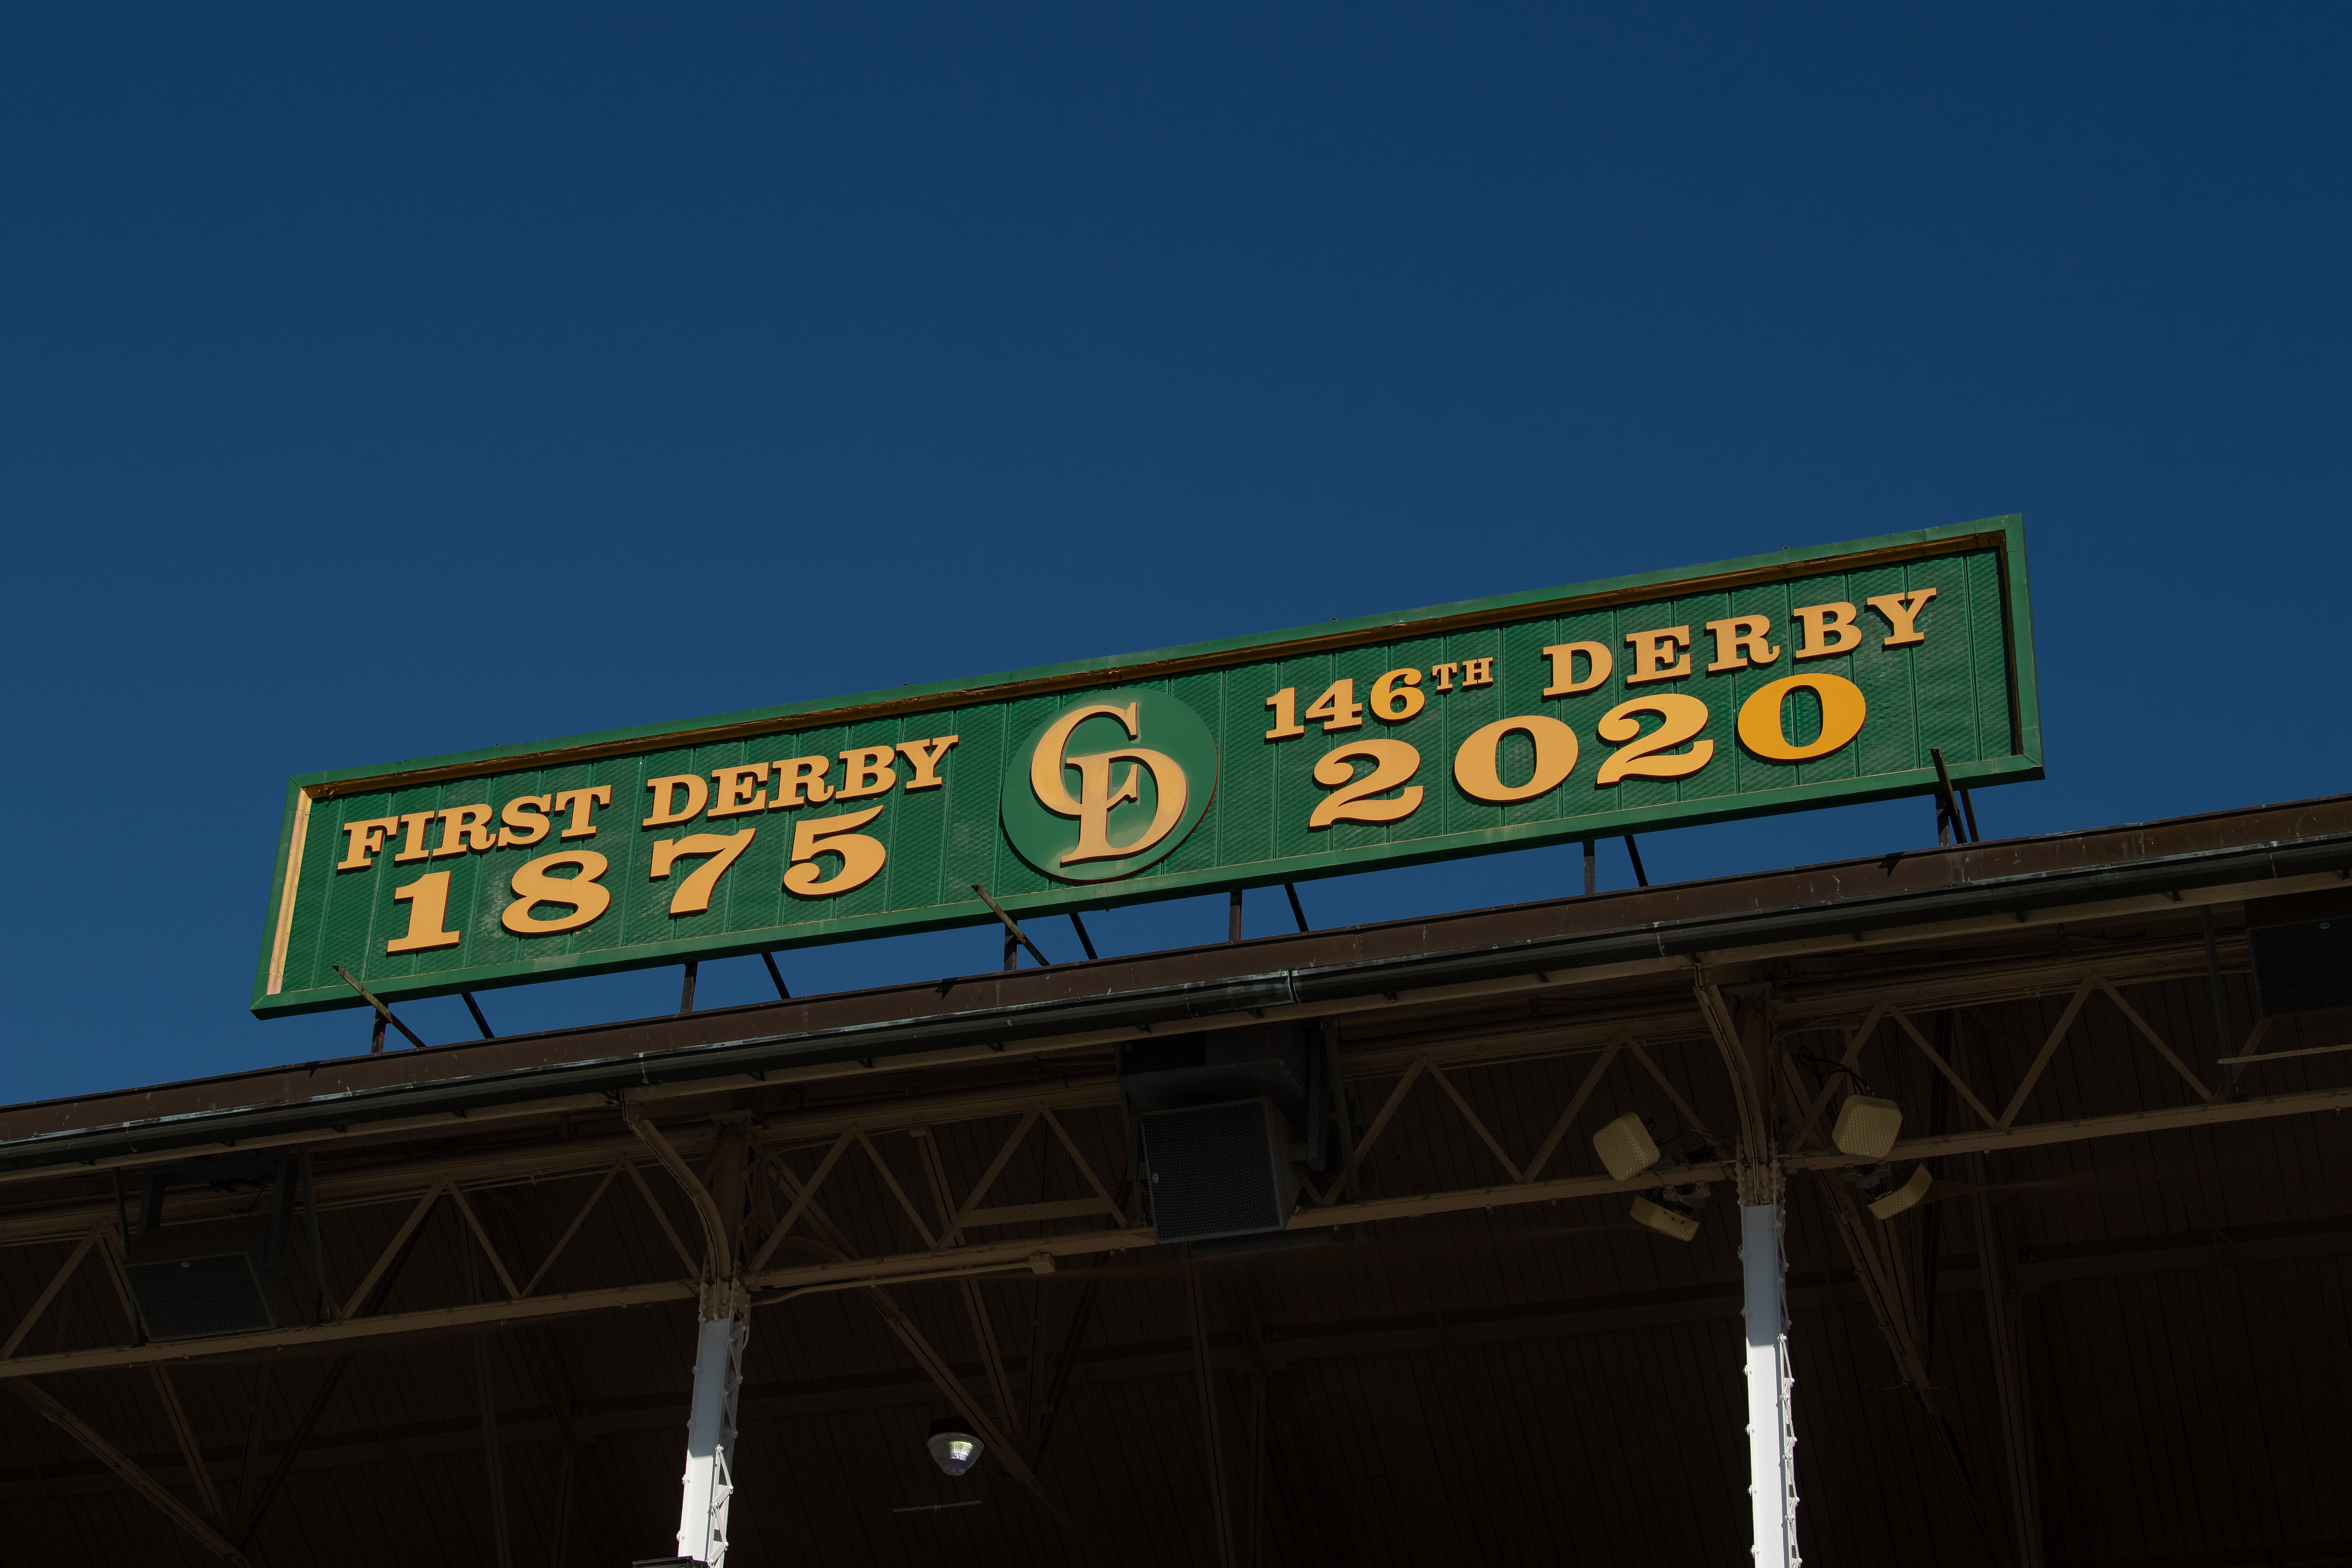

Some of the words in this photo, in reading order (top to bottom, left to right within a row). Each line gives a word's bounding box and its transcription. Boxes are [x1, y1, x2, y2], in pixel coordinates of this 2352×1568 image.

[1265, 656, 1494, 740] 146TH
[1542, 587, 1937, 697] DERBY
[338, 784, 612, 870] FIRST
[642, 734, 959, 827] DERBY
[1308, 672, 1866, 828] 2020
[386, 804, 887, 953] 1875
